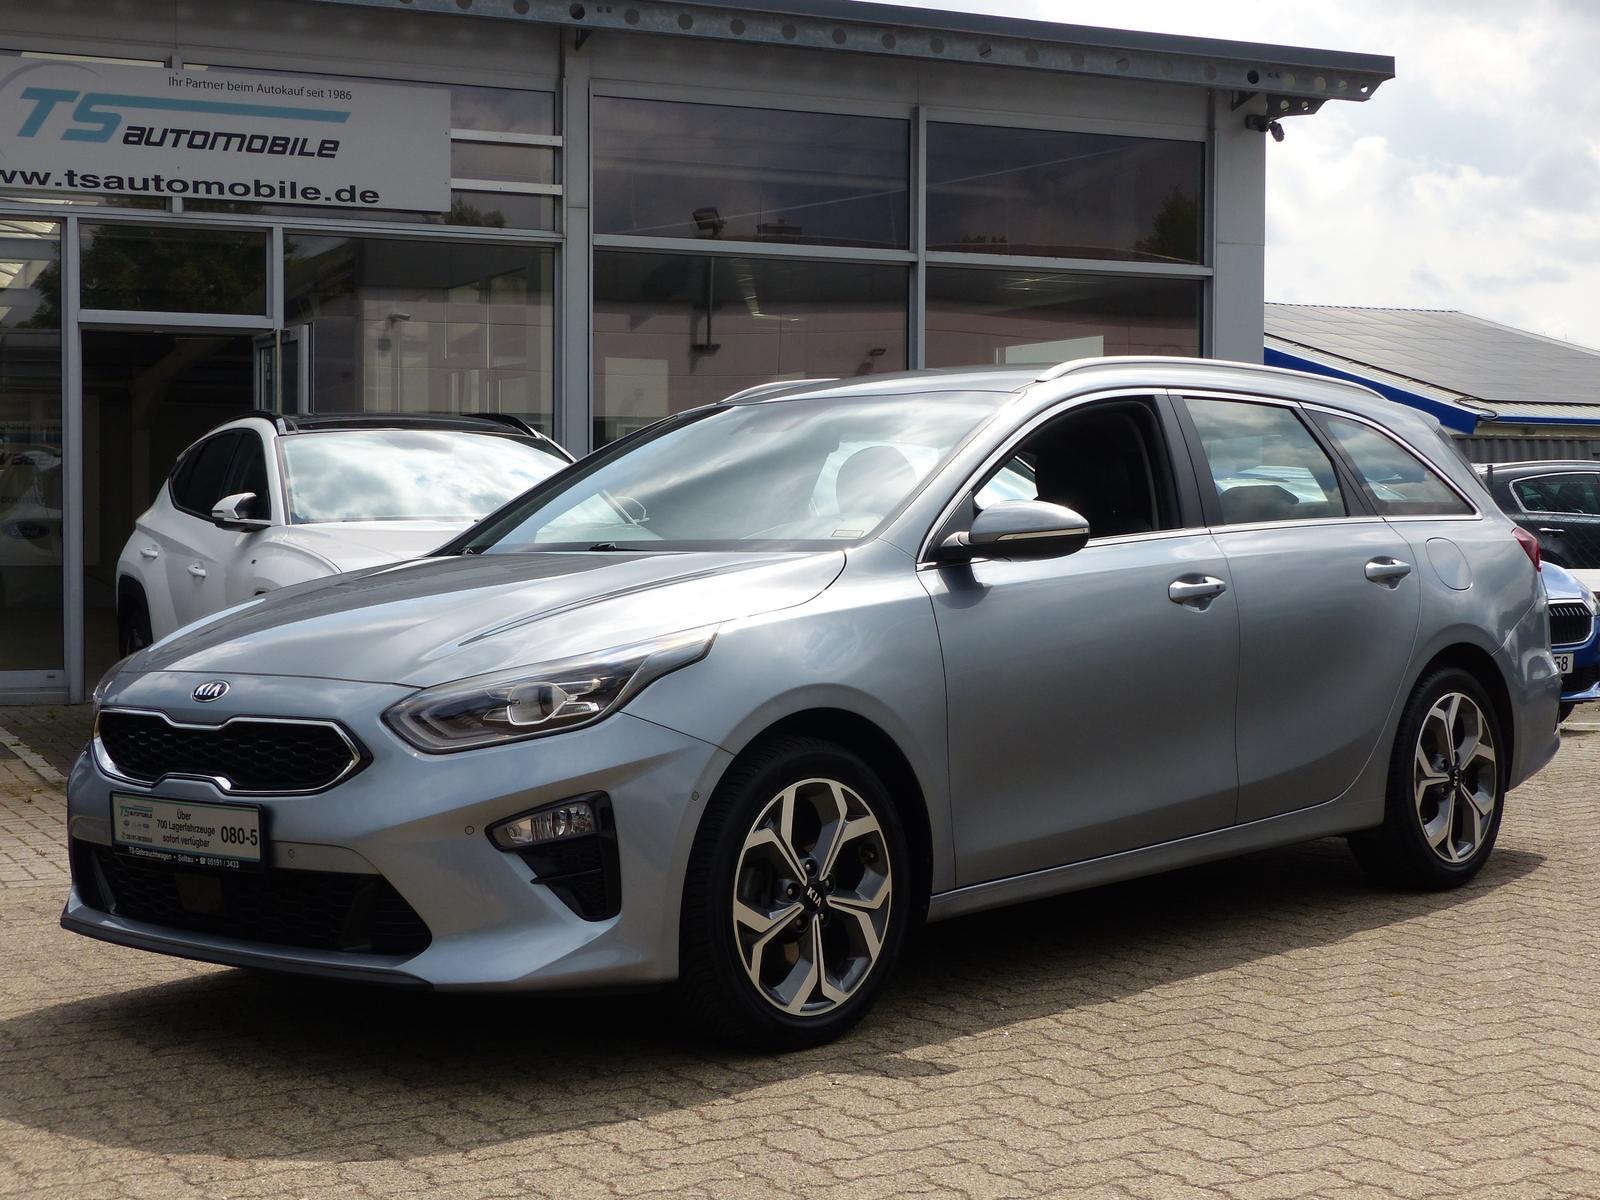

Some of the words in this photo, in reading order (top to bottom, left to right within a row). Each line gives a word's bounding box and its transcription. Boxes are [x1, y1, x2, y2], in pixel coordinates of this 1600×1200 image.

[168, 76, 183, 89] Ihr
[185, 77, 224, 92] Partner
[227, 80, 254, 94] beim
[256, 82, 305, 97] Autokauf
[306, 85, 325, 98] seit
[327, 87, 352, 100] 1986
[16, 87, 123, 143] TS
[195, 683, 222, 697] KIA
[176, 808, 192, 821] Über
[156, 819, 168, 830] 700
[168, 821, 216, 836] Lagerfahrzeuge
[220, 825, 258, 846] 080-5
[162, 834, 180, 845] sofort
[180, 836, 210, 849] verfügbar
[806, 886, 822, 908] KIA
